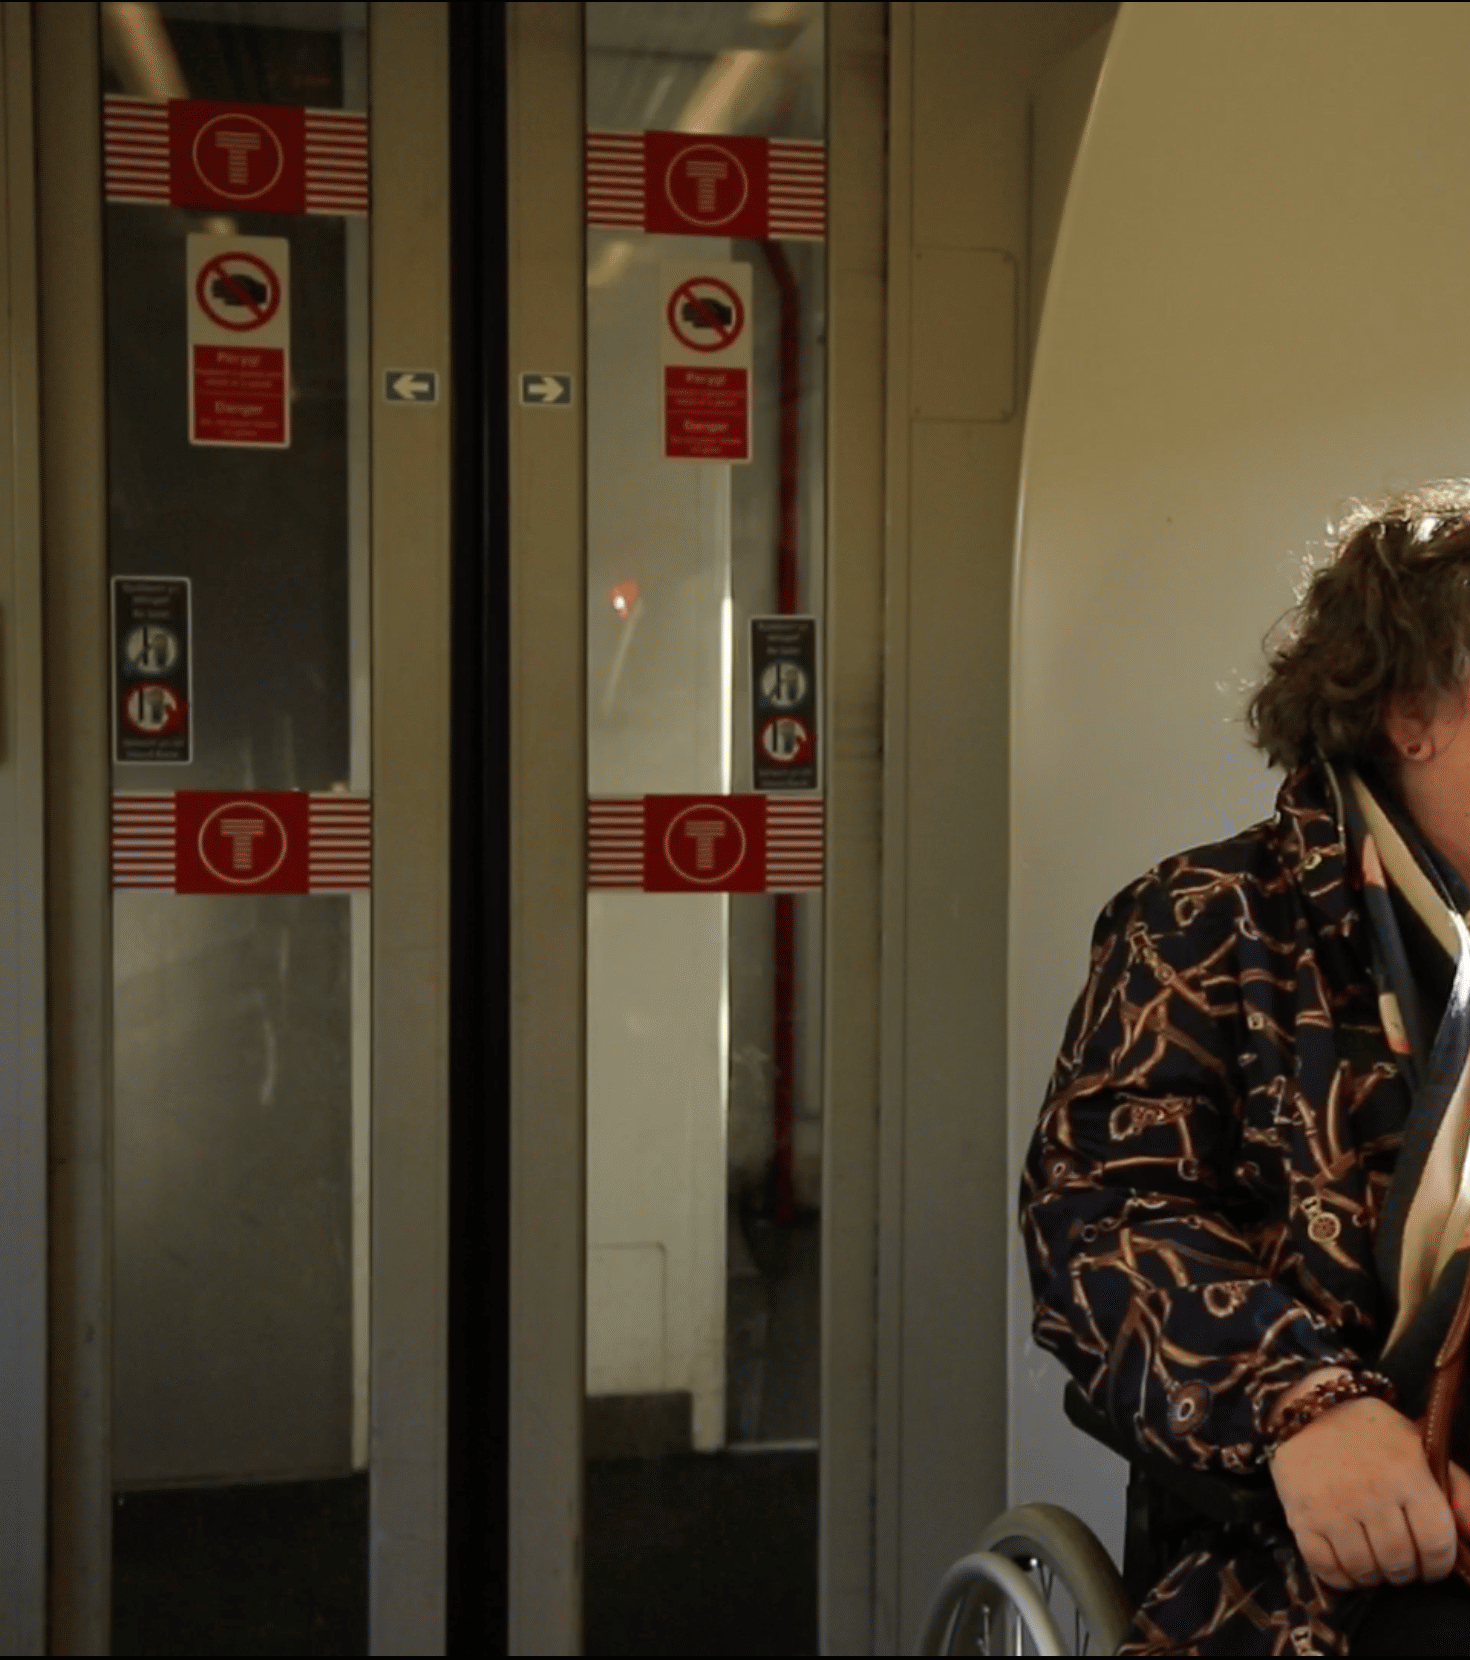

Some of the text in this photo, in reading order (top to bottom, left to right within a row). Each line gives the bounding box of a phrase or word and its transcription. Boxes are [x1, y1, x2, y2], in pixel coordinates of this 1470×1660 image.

[215, 130, 261, 186] T
[686, 160, 729, 213] T
[214, 400, 263, 417] Danger
[220, 819, 264, 870] T
[685, 820, 725, 870] T
